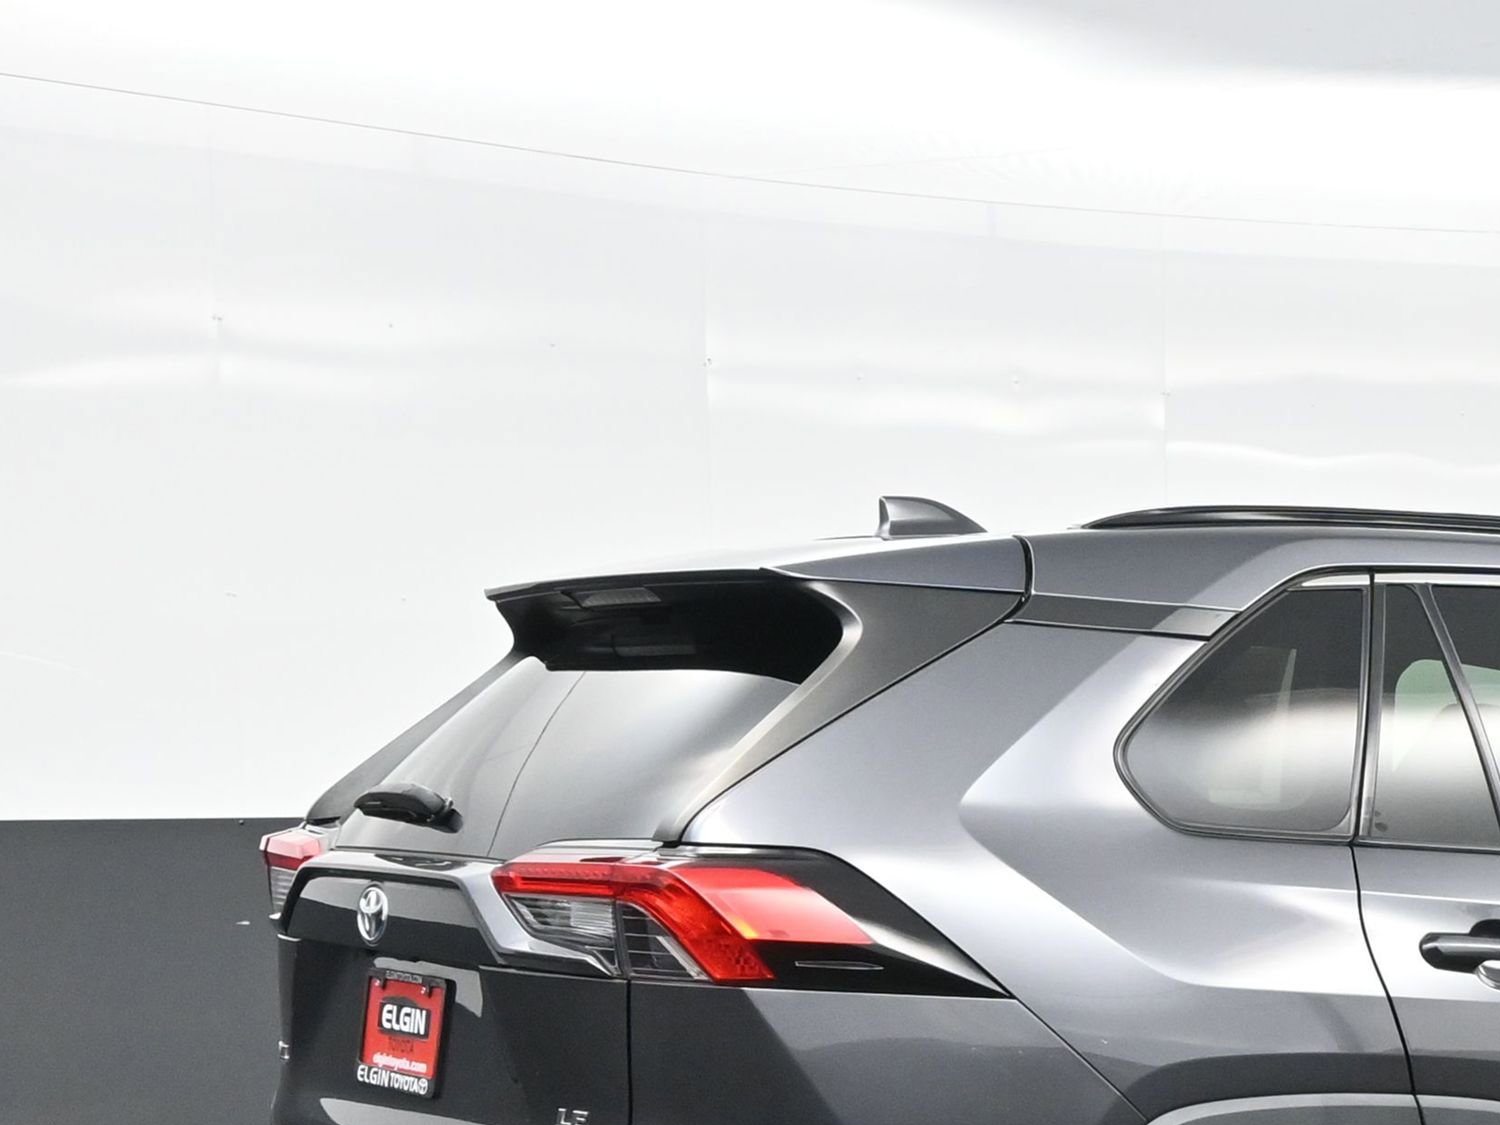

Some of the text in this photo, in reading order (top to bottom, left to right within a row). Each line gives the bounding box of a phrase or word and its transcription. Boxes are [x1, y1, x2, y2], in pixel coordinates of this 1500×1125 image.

[382, 1003, 427, 1035] ELGIN
[357, 1064, 419, 1093] ELGIN TOYOTA
